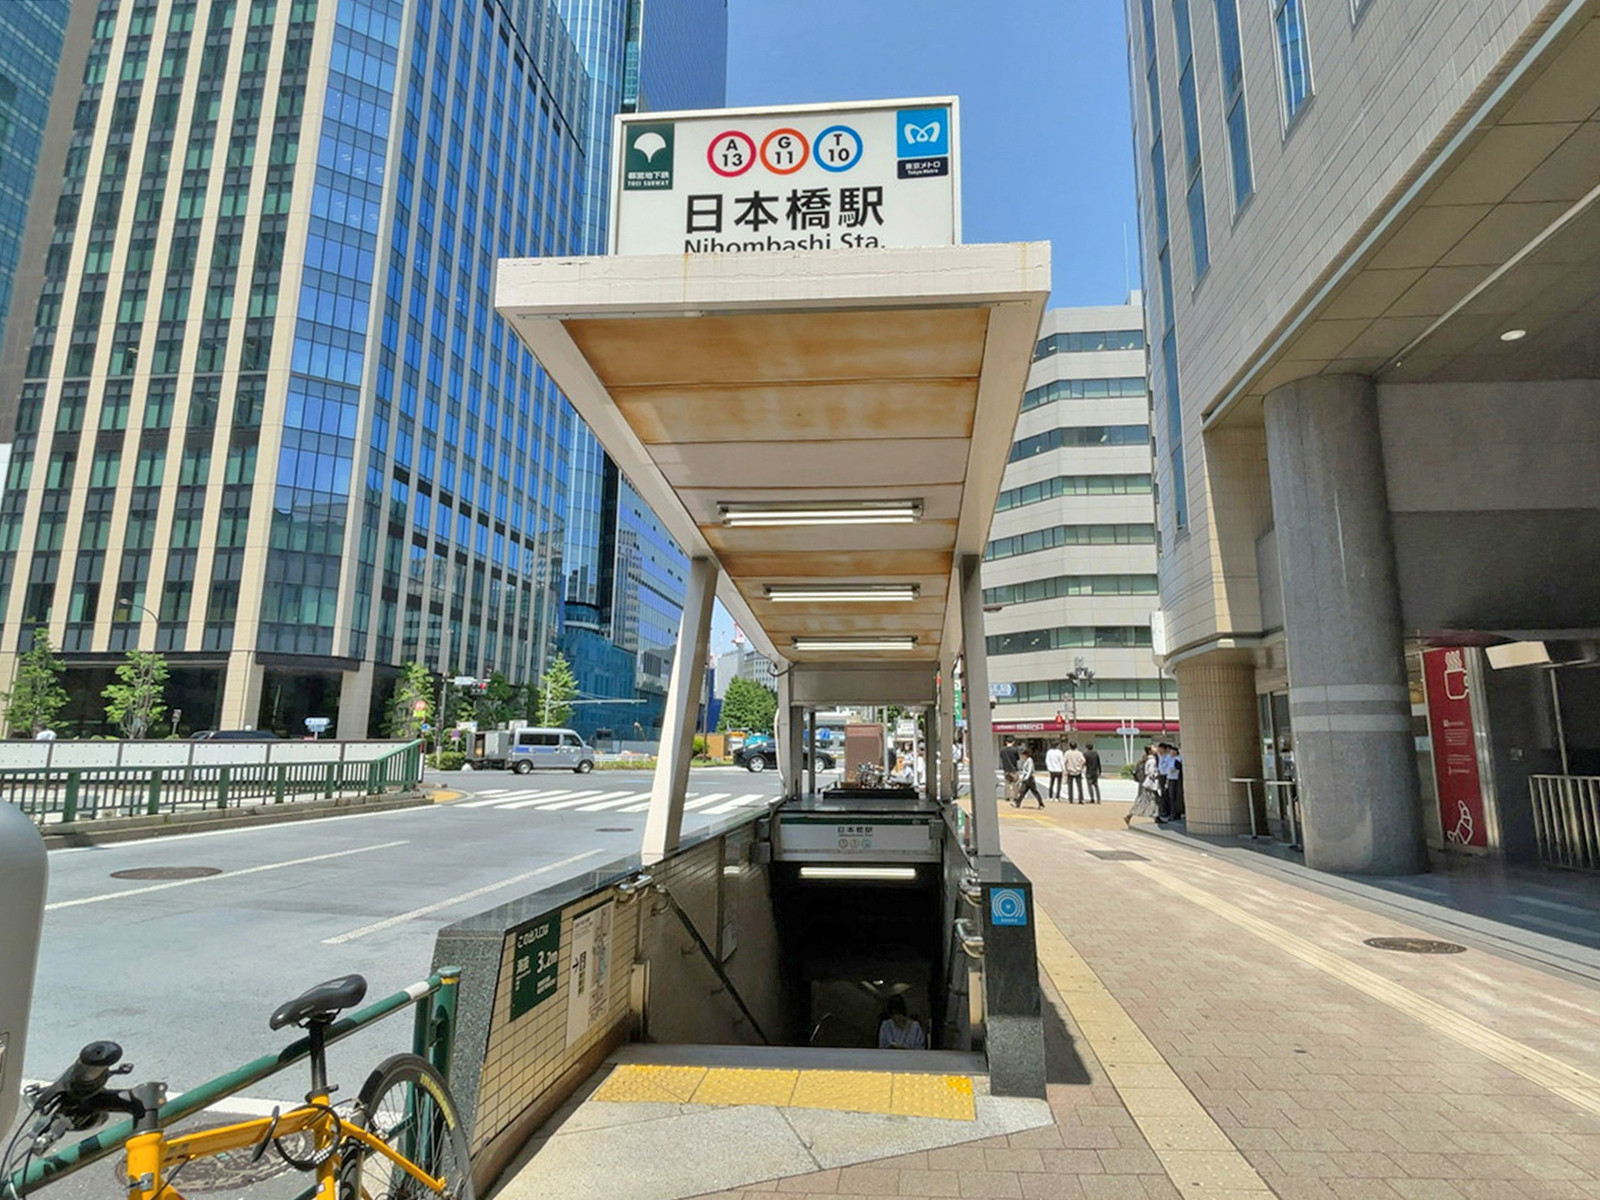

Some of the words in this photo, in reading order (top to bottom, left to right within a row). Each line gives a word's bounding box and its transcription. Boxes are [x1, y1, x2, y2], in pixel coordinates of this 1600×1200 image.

[725, 139, 738, 151] A
[777, 136, 791, 149] G
[833, 133, 843, 146] T
[722, 153, 743, 167] 13
[775, 151, 793, 164] 11
[828, 148, 850, 162] 10
[686, 186, 885, 234] 日本橋駅
[684, 233, 831, 253] Nihombashi
[840, 232, 886, 248] Sta.
